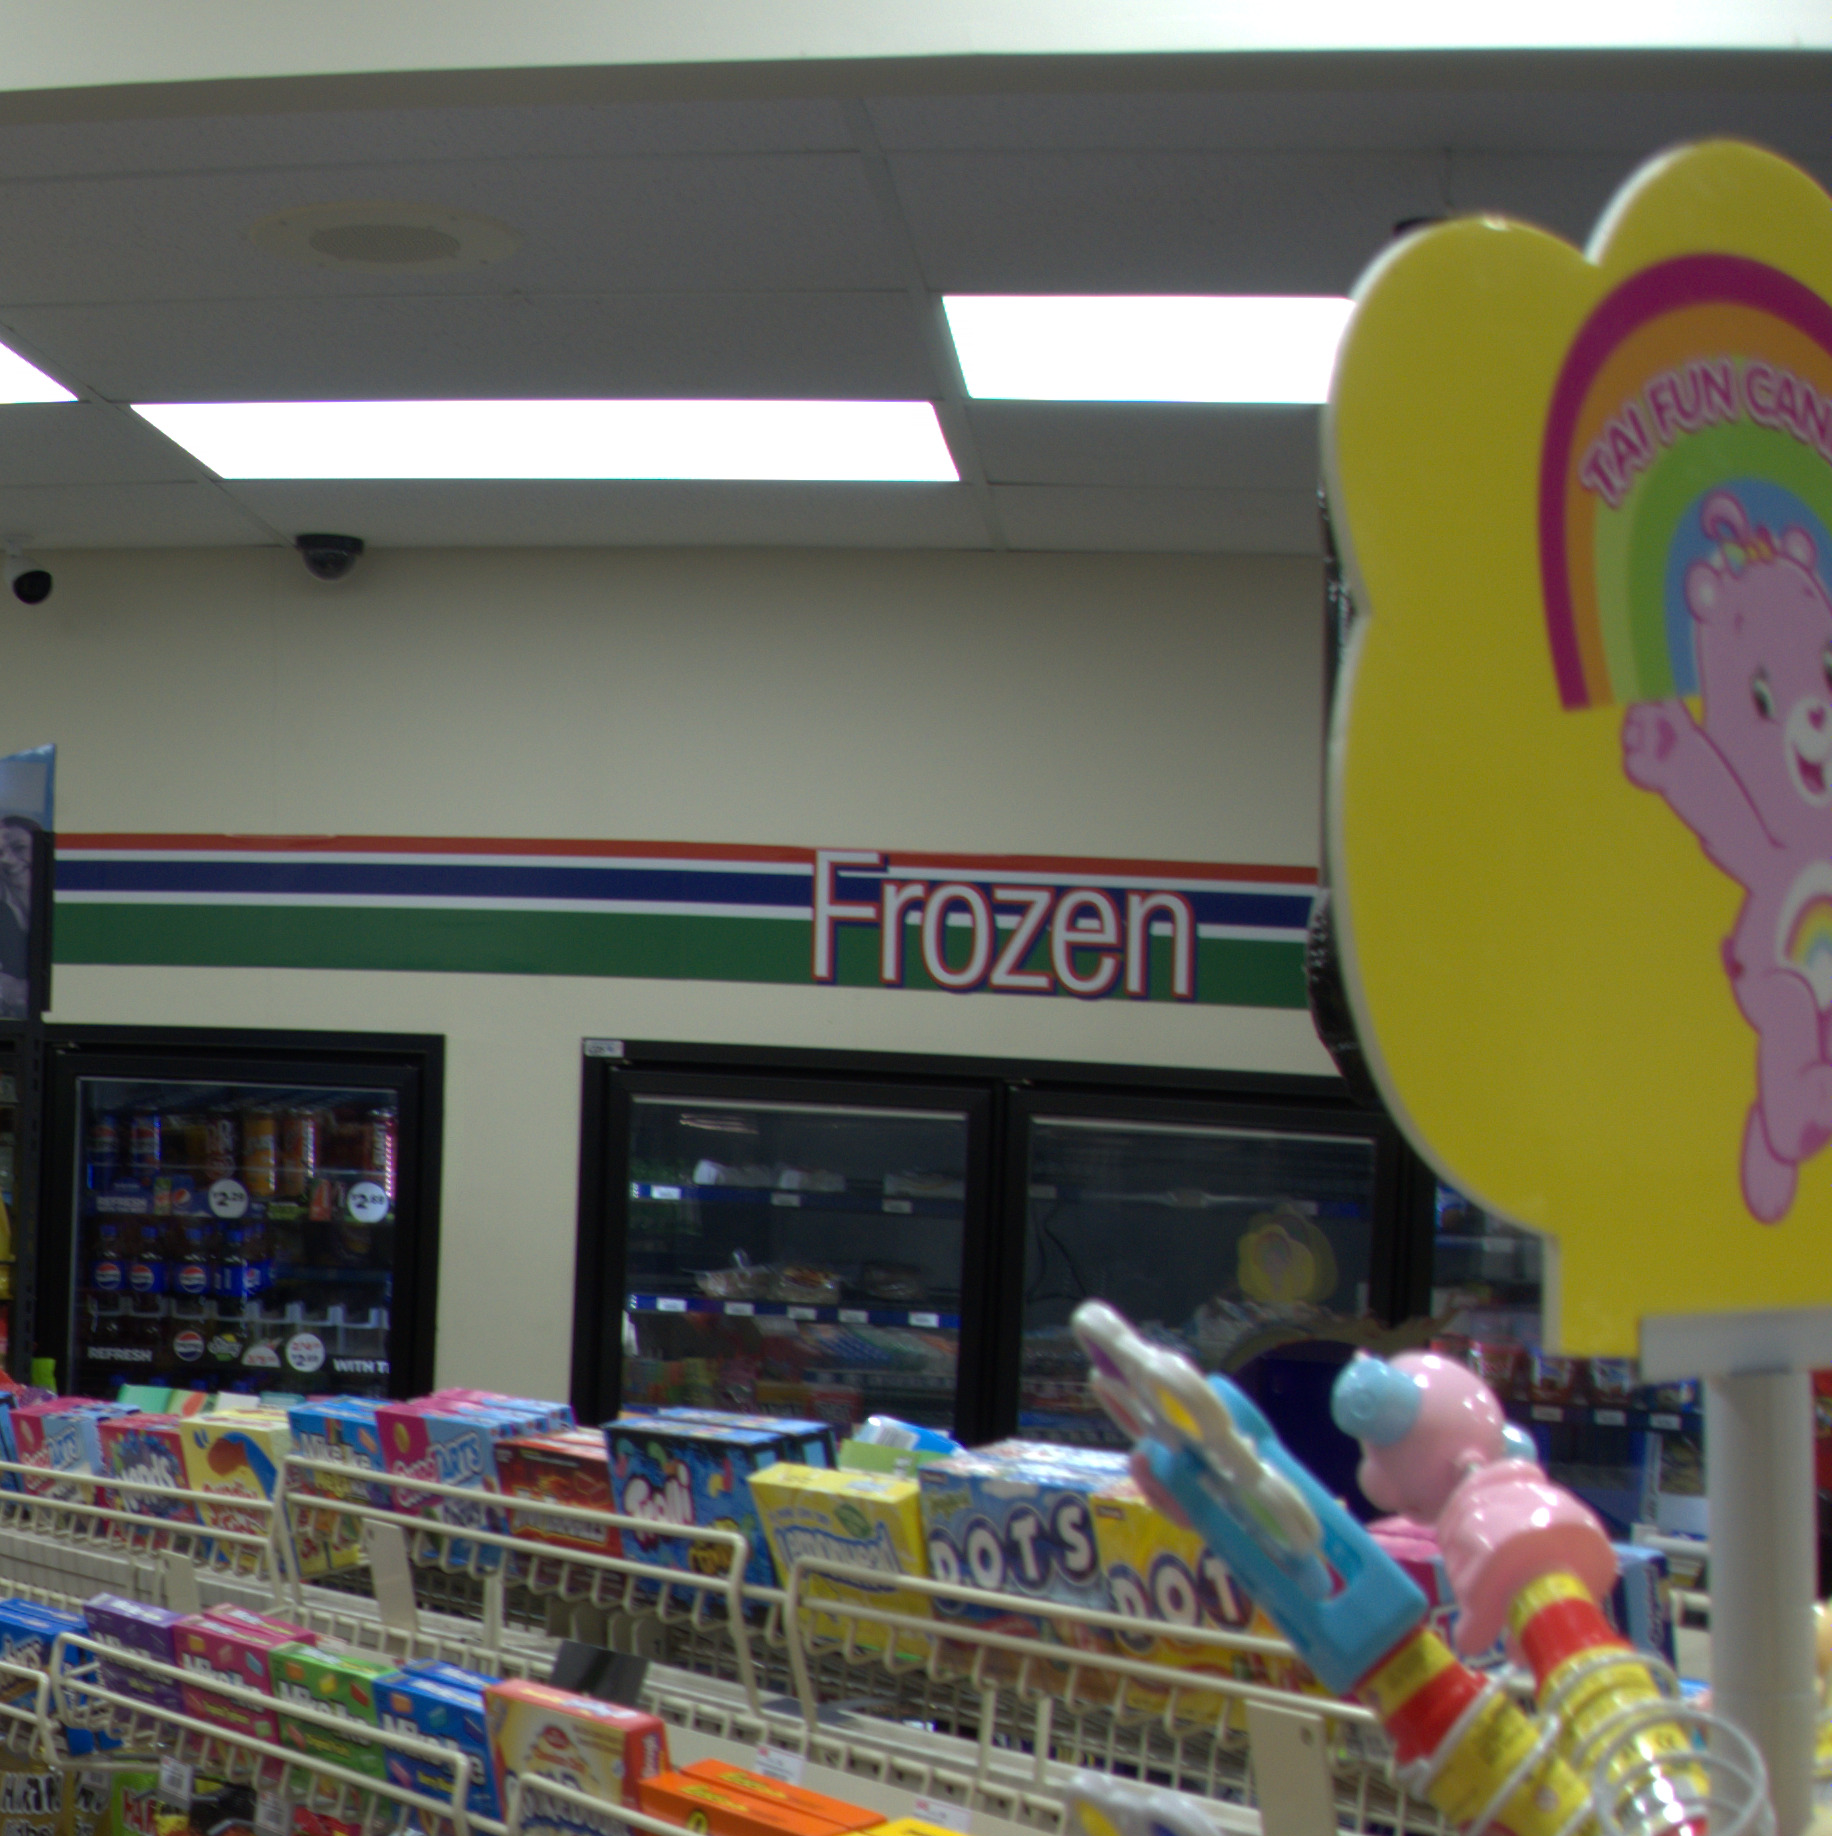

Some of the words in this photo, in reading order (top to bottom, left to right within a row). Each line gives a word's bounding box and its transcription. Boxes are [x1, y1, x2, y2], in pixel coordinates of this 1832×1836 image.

[1580, 402, 1654, 509] TAI
[1647, 360, 1738, 447] FUN
[812, 848, 1198, 1001] Frozen
[88, 1347, 152, 1363] REFRESH
[930, 1492, 1097, 1596] DOTS
